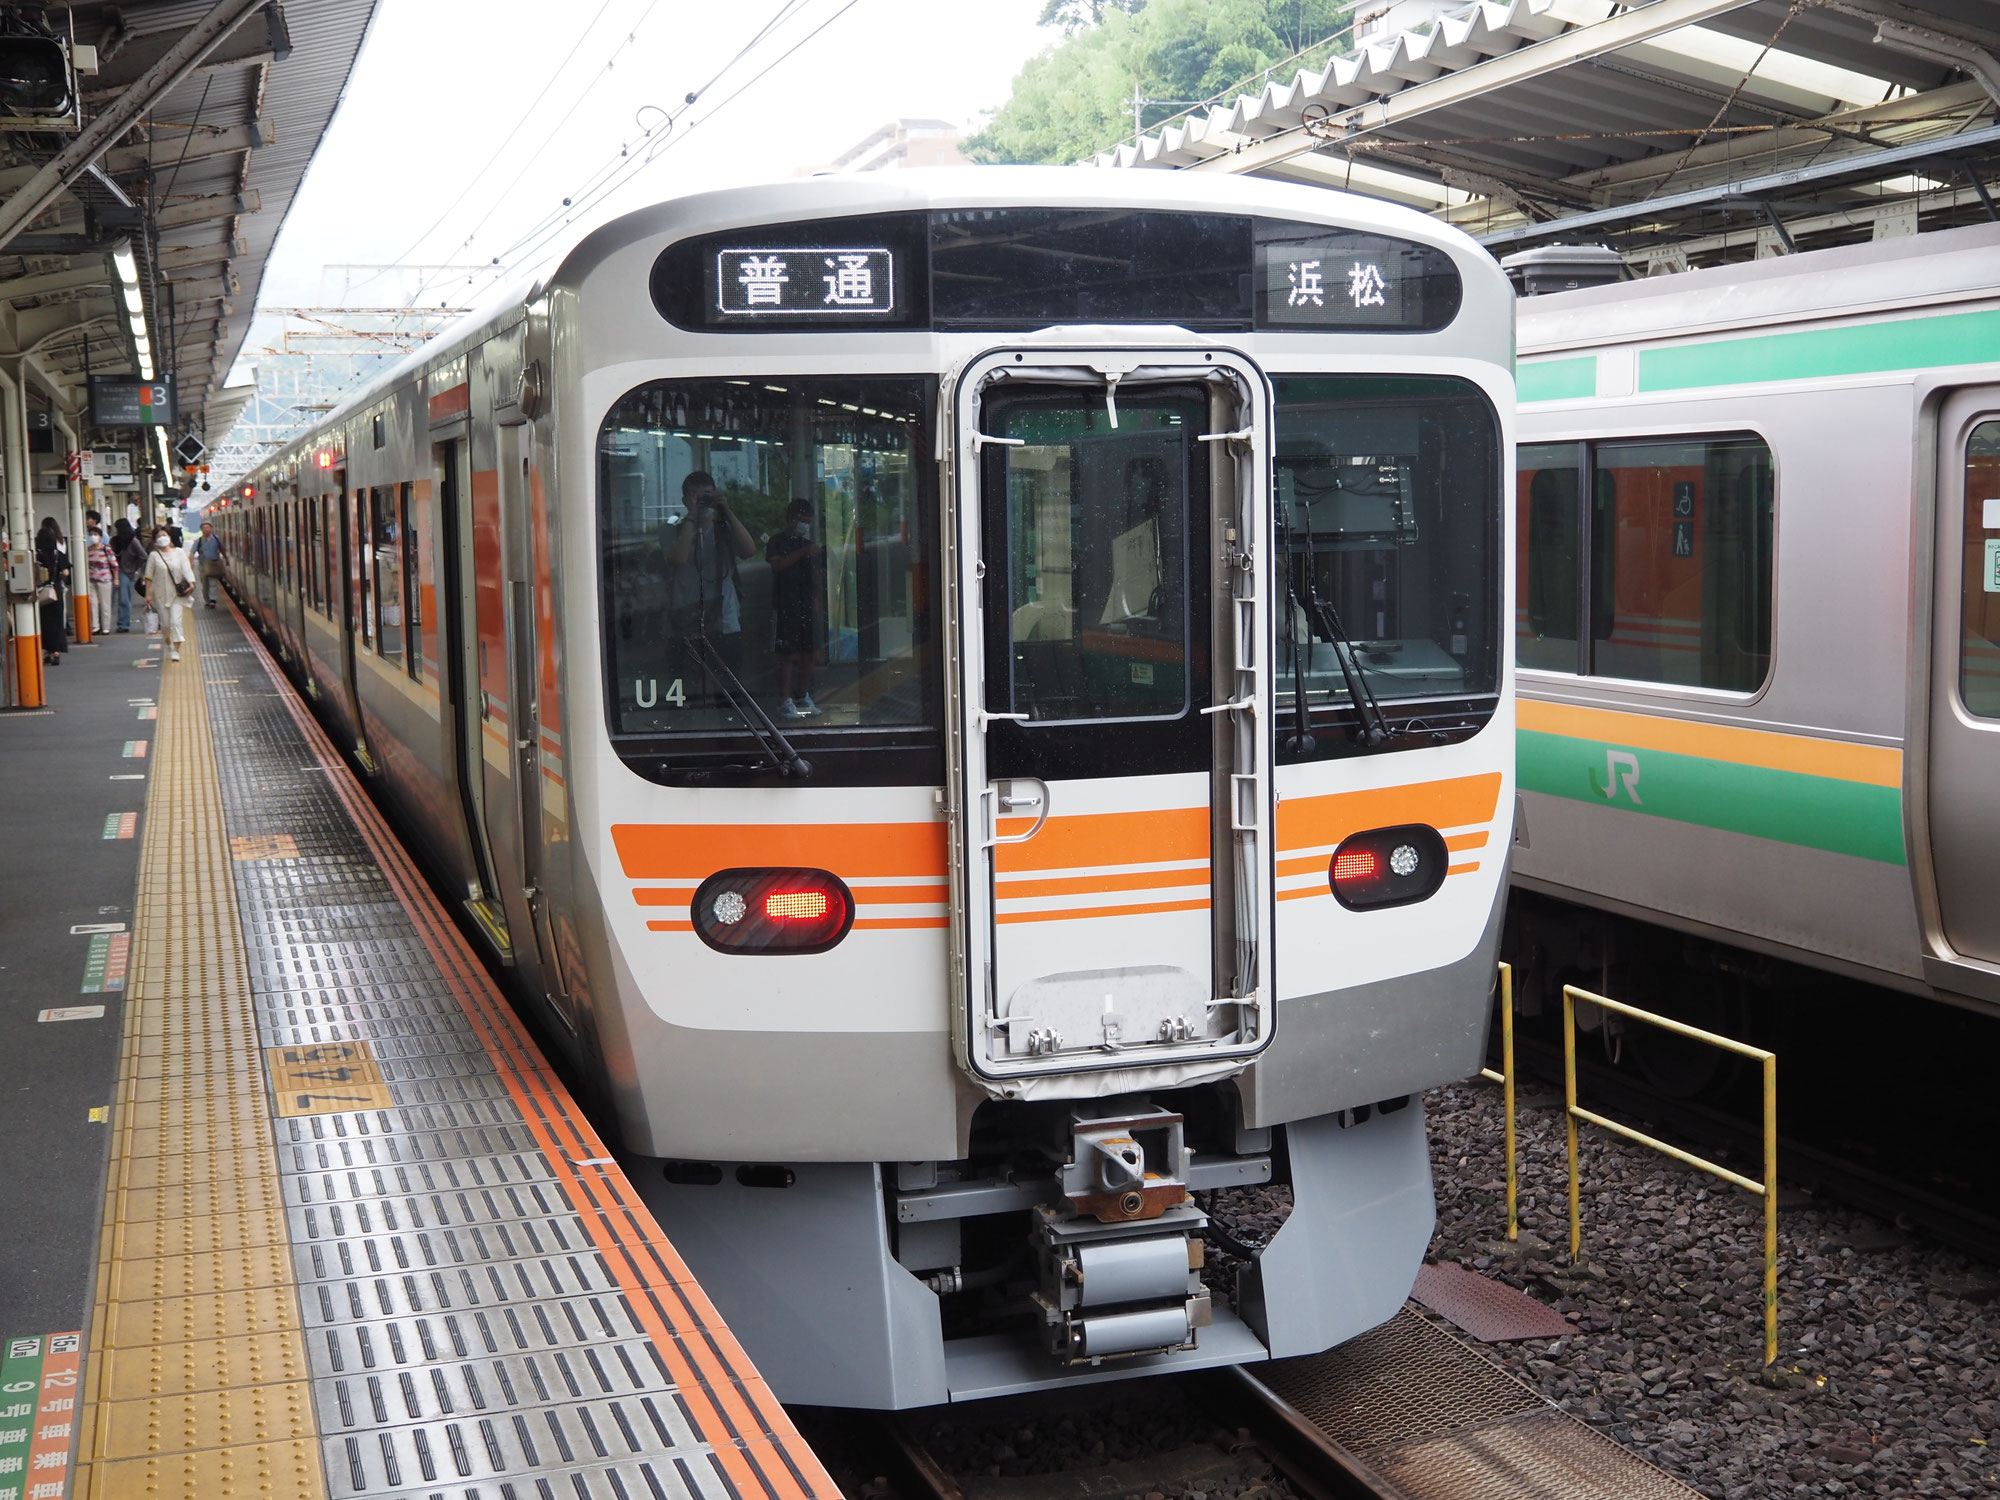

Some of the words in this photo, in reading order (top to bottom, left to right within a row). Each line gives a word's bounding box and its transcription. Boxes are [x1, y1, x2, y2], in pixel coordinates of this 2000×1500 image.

[738, 255, 874, 305] 普通
[1287, 261, 1385, 308] 浜松
[153, 386, 167, 406] 3
[38, 413, 48, 427] 3
[1588, 749, 1643, 805] JR
